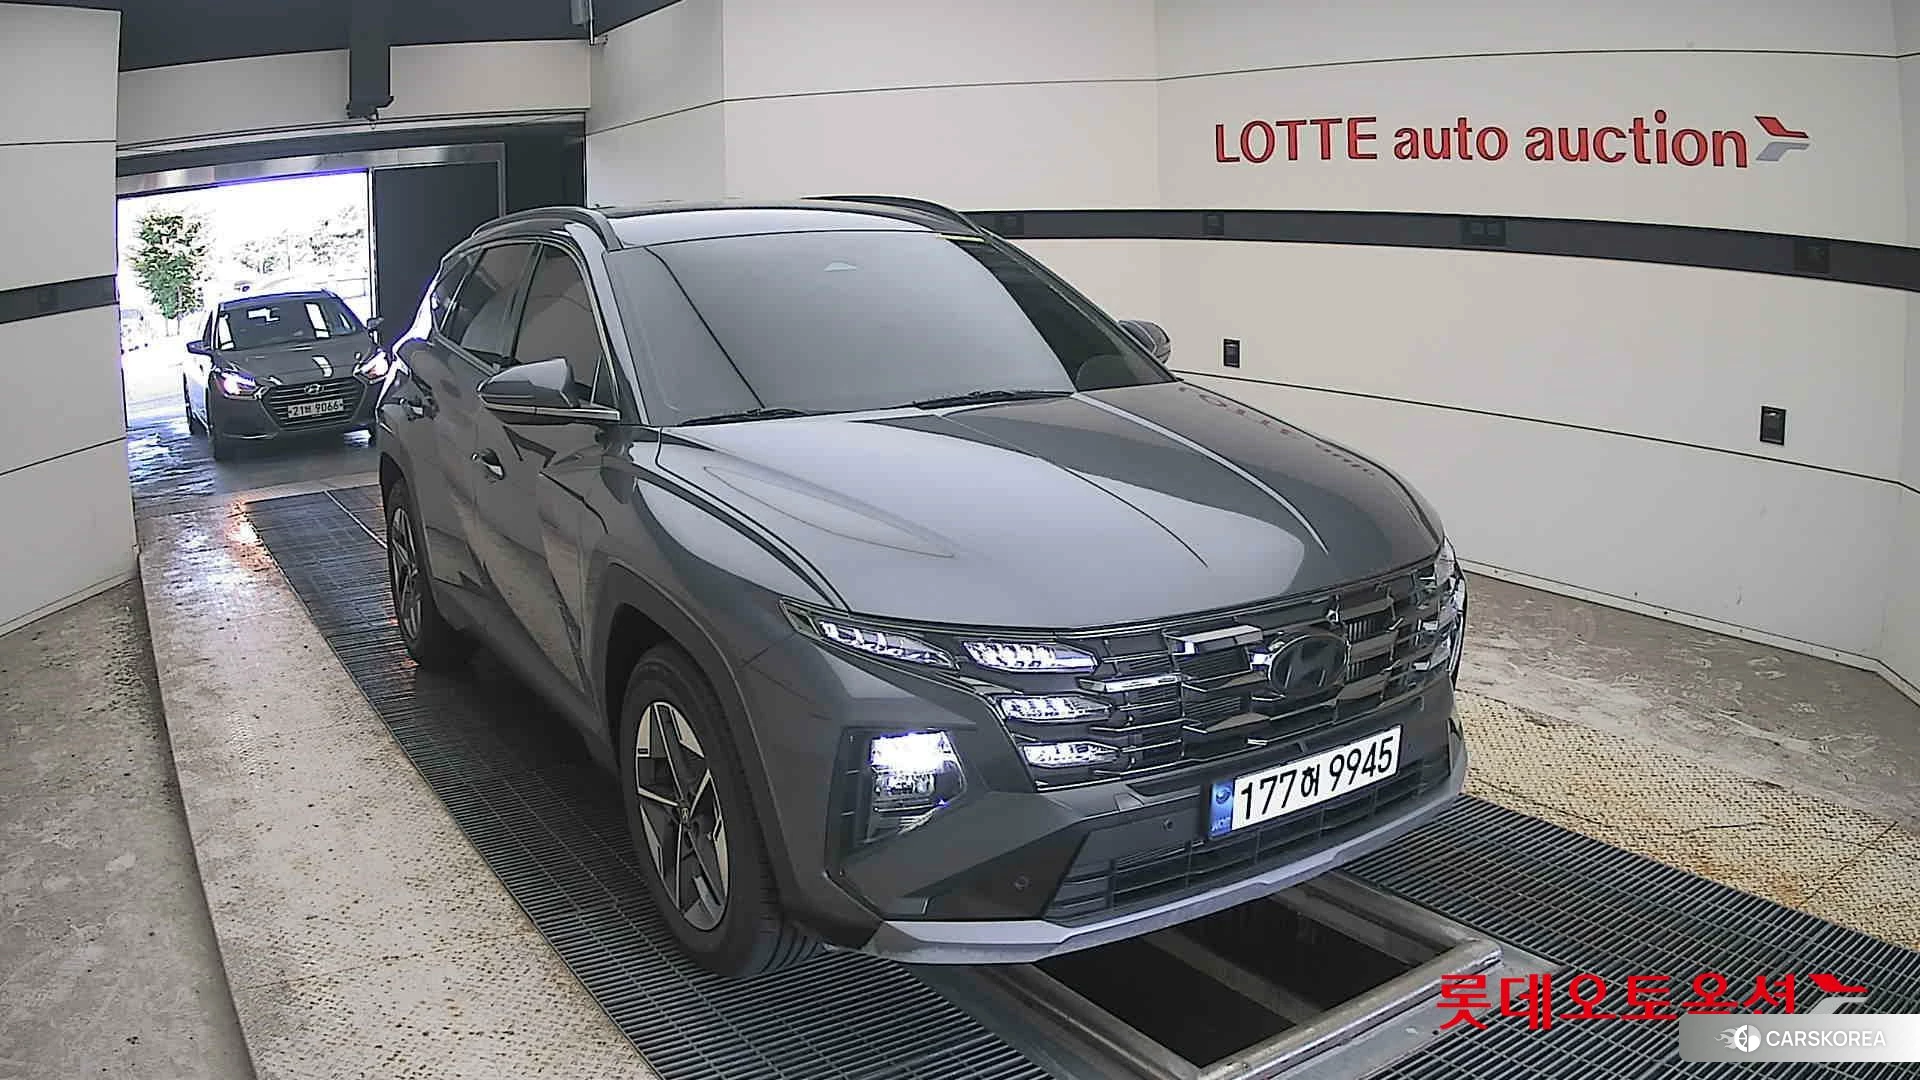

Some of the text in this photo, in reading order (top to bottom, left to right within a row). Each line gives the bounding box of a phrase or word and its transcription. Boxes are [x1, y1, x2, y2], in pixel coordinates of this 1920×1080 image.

[1215, 109, 1748, 168] LOTTE auto auction
[1241, 736, 1394, 820] 177허 9945
